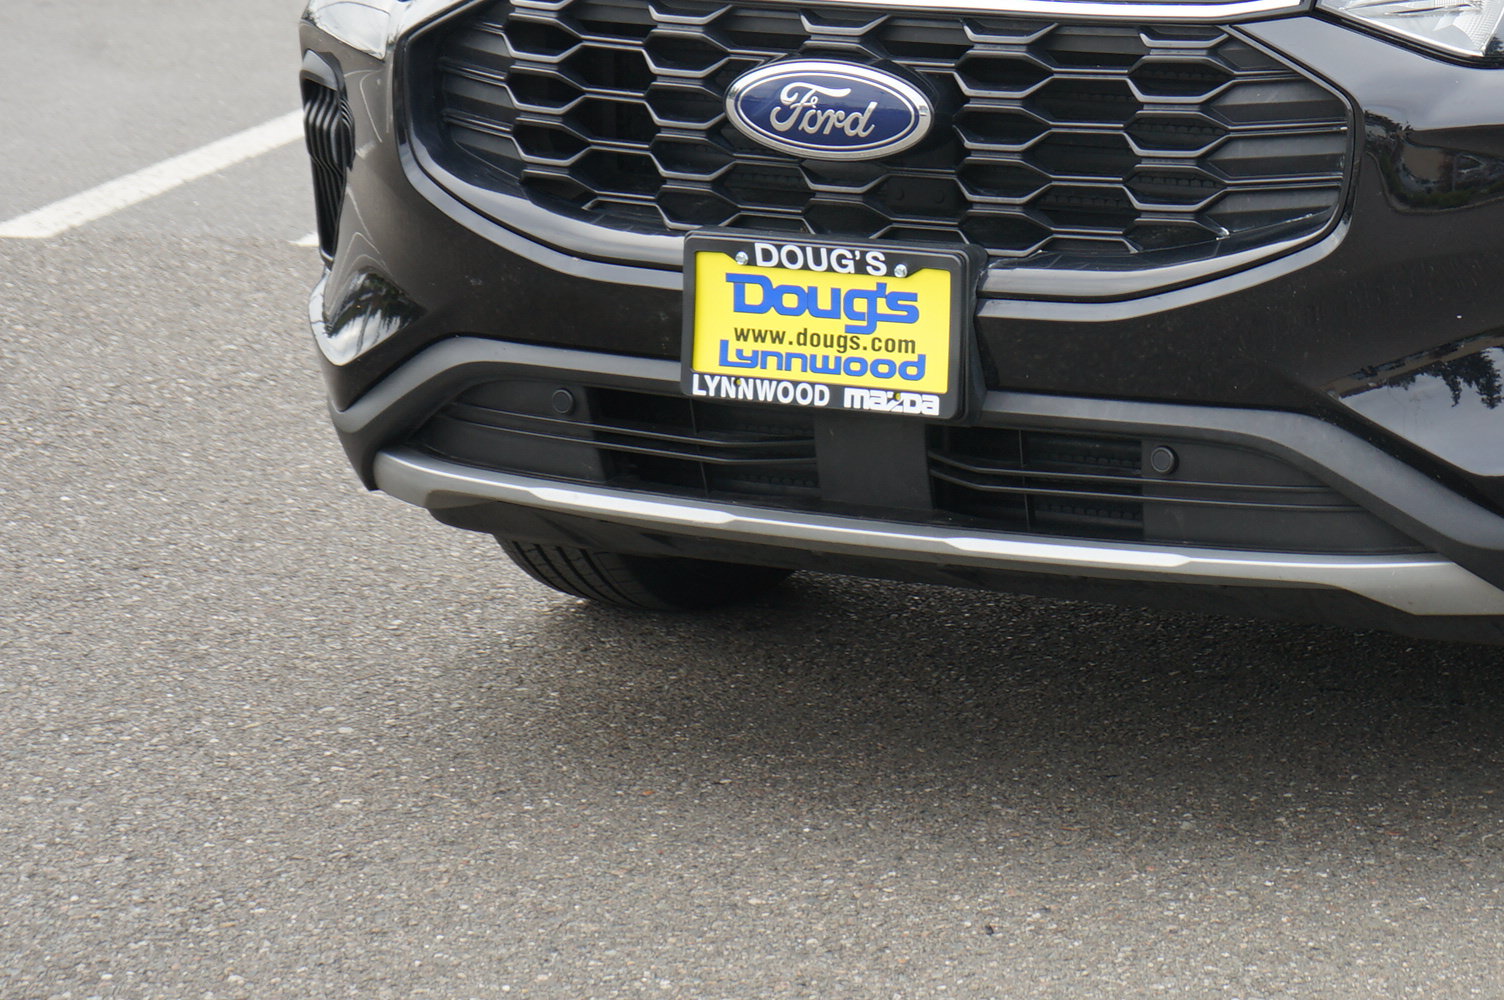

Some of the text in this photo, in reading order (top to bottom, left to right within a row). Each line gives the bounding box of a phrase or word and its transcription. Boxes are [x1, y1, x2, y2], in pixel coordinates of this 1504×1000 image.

[770, 82, 878, 138] Ford
[754, 242, 888, 276] DOUG'S
[725, 272, 920, 335] Doug's
[734, 326, 916, 354] www.dougs.com
[719, 339, 927, 381] Lynnwood
[692, 373, 830, 407] LYNNWOOD
